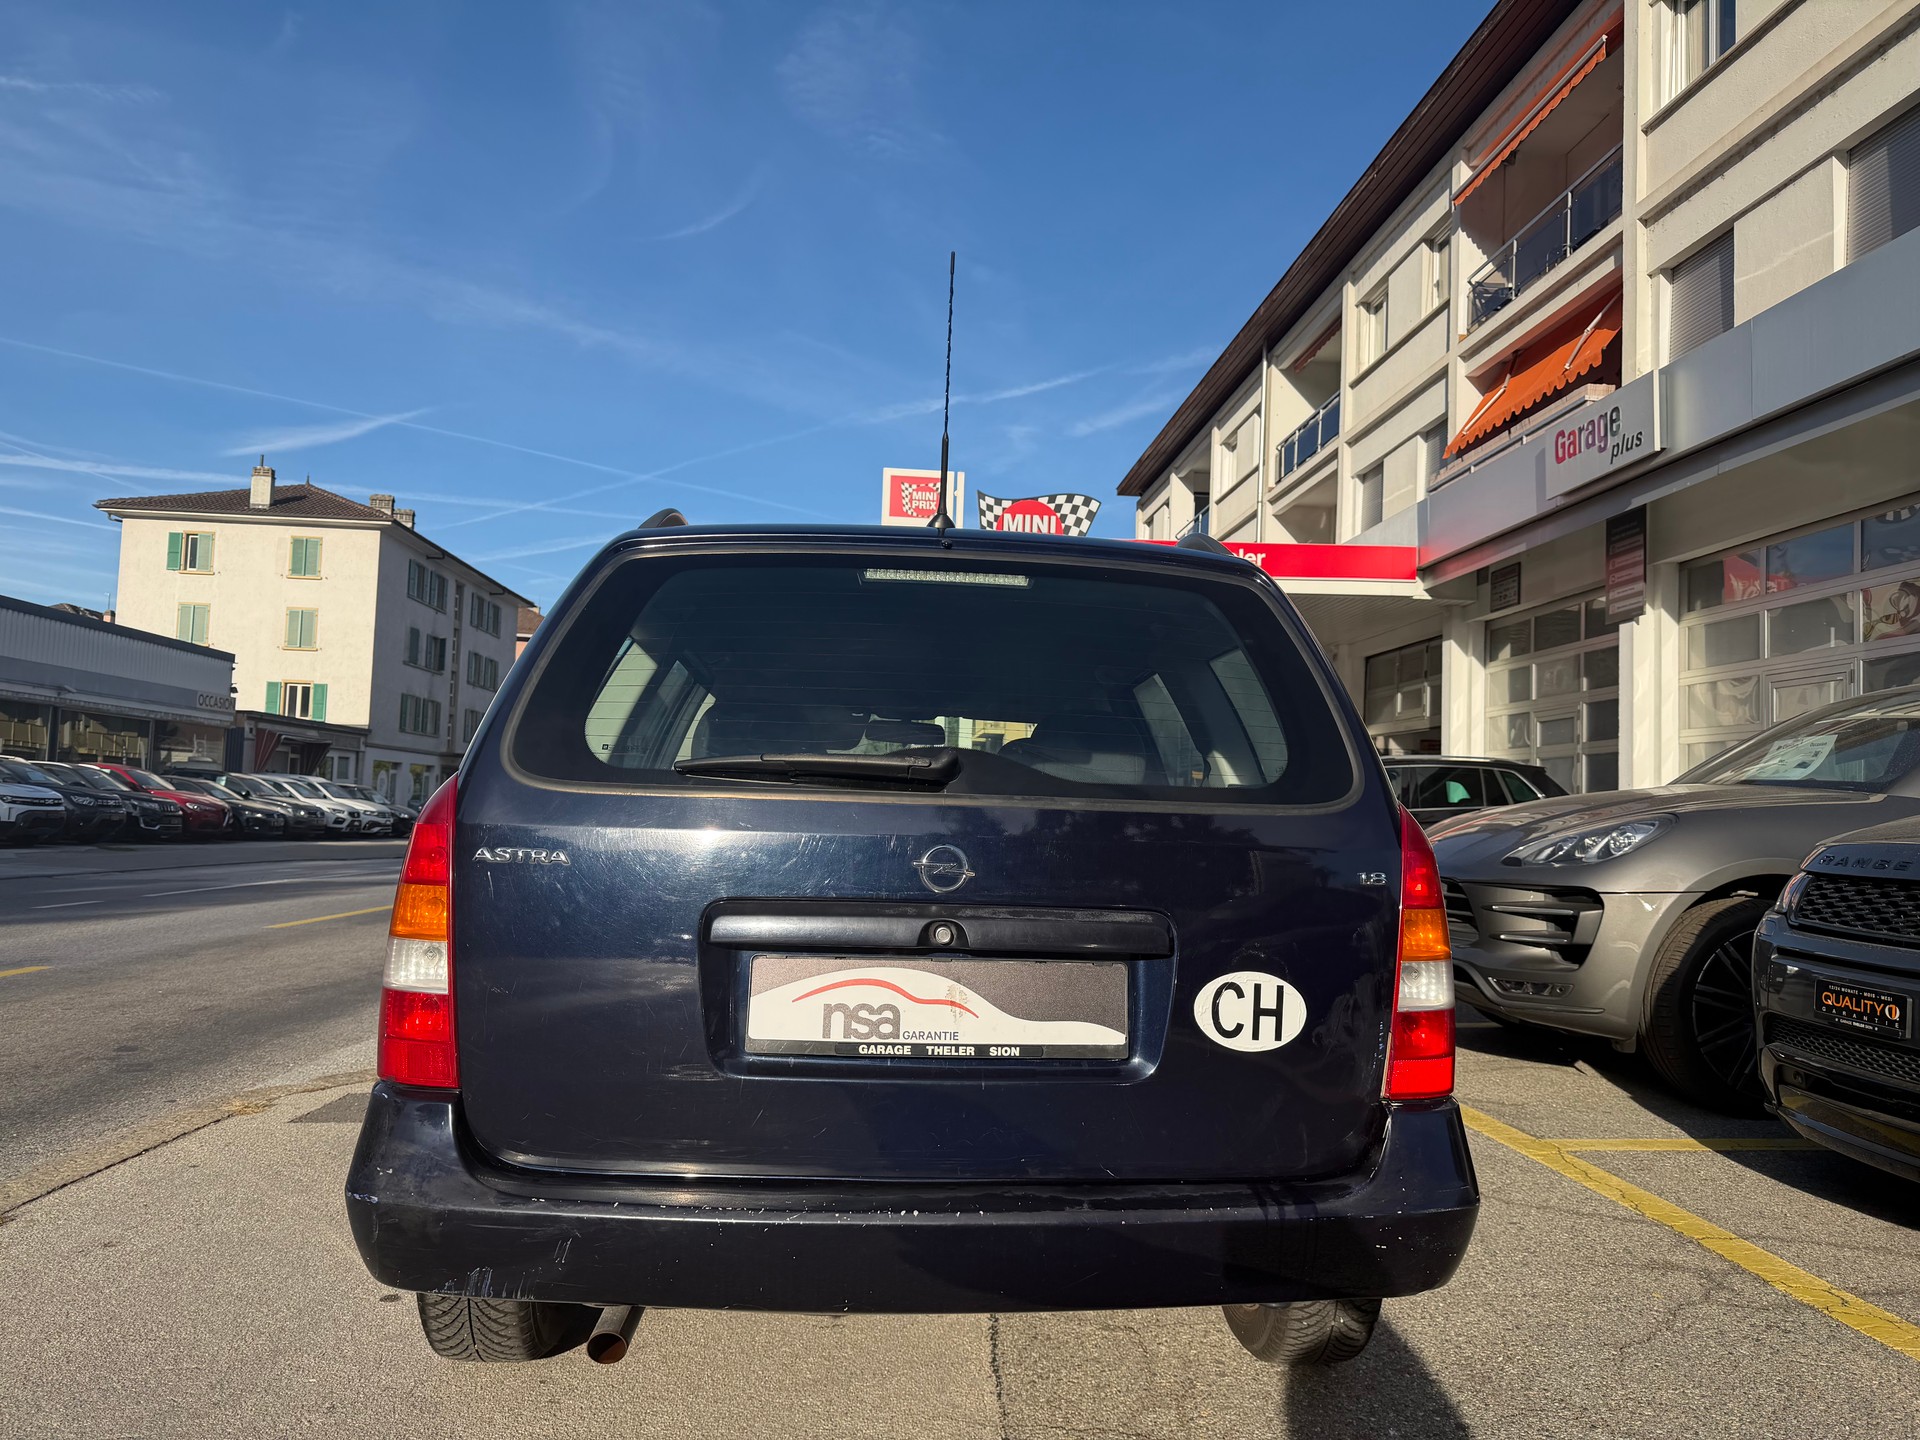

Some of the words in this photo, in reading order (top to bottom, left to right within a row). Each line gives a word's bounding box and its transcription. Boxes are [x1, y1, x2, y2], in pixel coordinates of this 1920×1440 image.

[1555, 406, 1621, 465] Garage
[1610, 431, 1643, 465] plus
[911, 500, 938, 511] PRIX
[912, 491, 938, 501] MINI
[1003, 513, 1057, 535] MINI
[1233, 548, 1266, 567] ler
[472, 847, 571, 866] ASTRA
[1819, 854, 1914, 872] RANGE
[822, 1002, 901, 1040] nsa
[1211, 981, 1285, 1042] CH
[902, 1030, 960, 1042] GARANTIE
[858, 1044, 912, 1056] GARAGE
[926, 1045, 975, 1057] THELER
[989, 1046, 1020, 1058] SION
